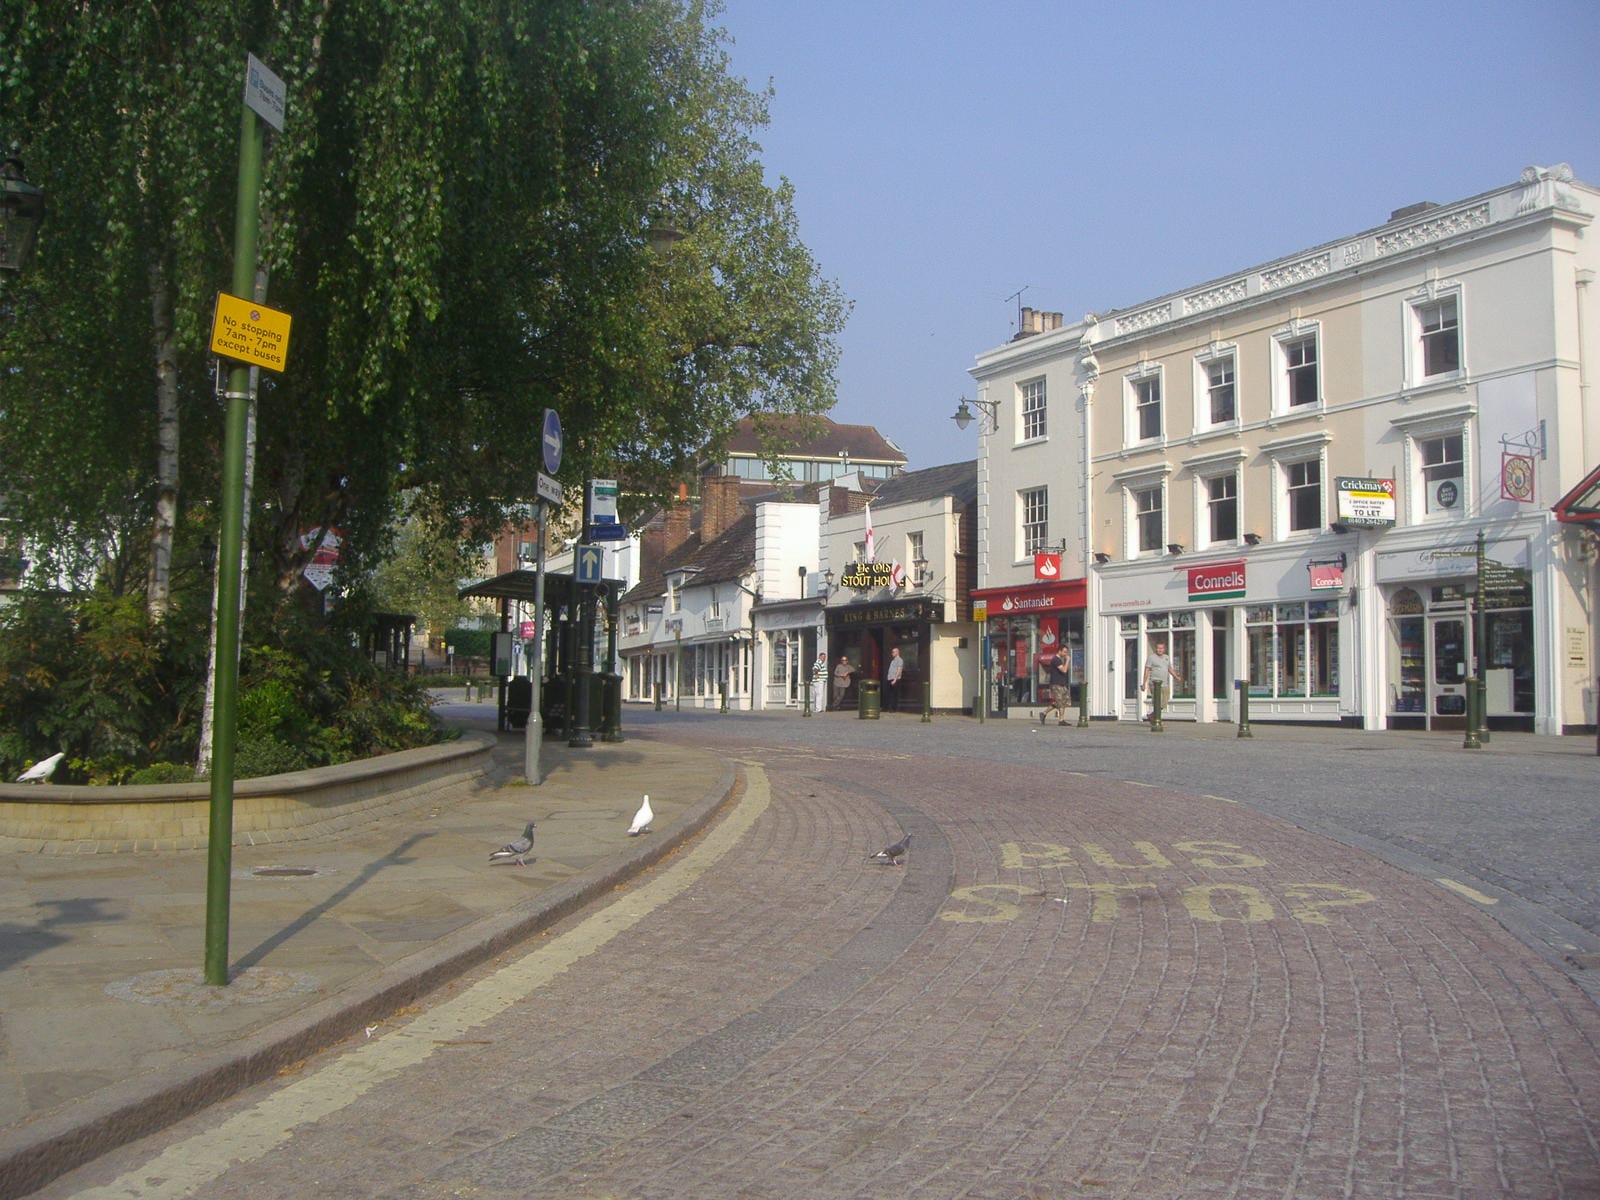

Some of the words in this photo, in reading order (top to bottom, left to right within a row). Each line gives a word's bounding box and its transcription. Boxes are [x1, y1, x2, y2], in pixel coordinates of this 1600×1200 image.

[222, 315, 237, 327] No
[241, 322, 282, 342] stopping
[226, 327, 247, 342] 7am
[256, 337, 277, 351] 7pm
[217, 338, 250, 354] except
[254, 348, 281, 364] buses
[1341, 480, 1381, 492] Crickmay
[842, 576, 871, 586] STOUT
[1195, 571, 1245, 590] Connells
[1315, 577, 1343, 586] Connells
[1014, 593, 1055, 610] Santander
[1000, 840, 1269, 869] BUS
[938, 883, 1376, 925] STOP
